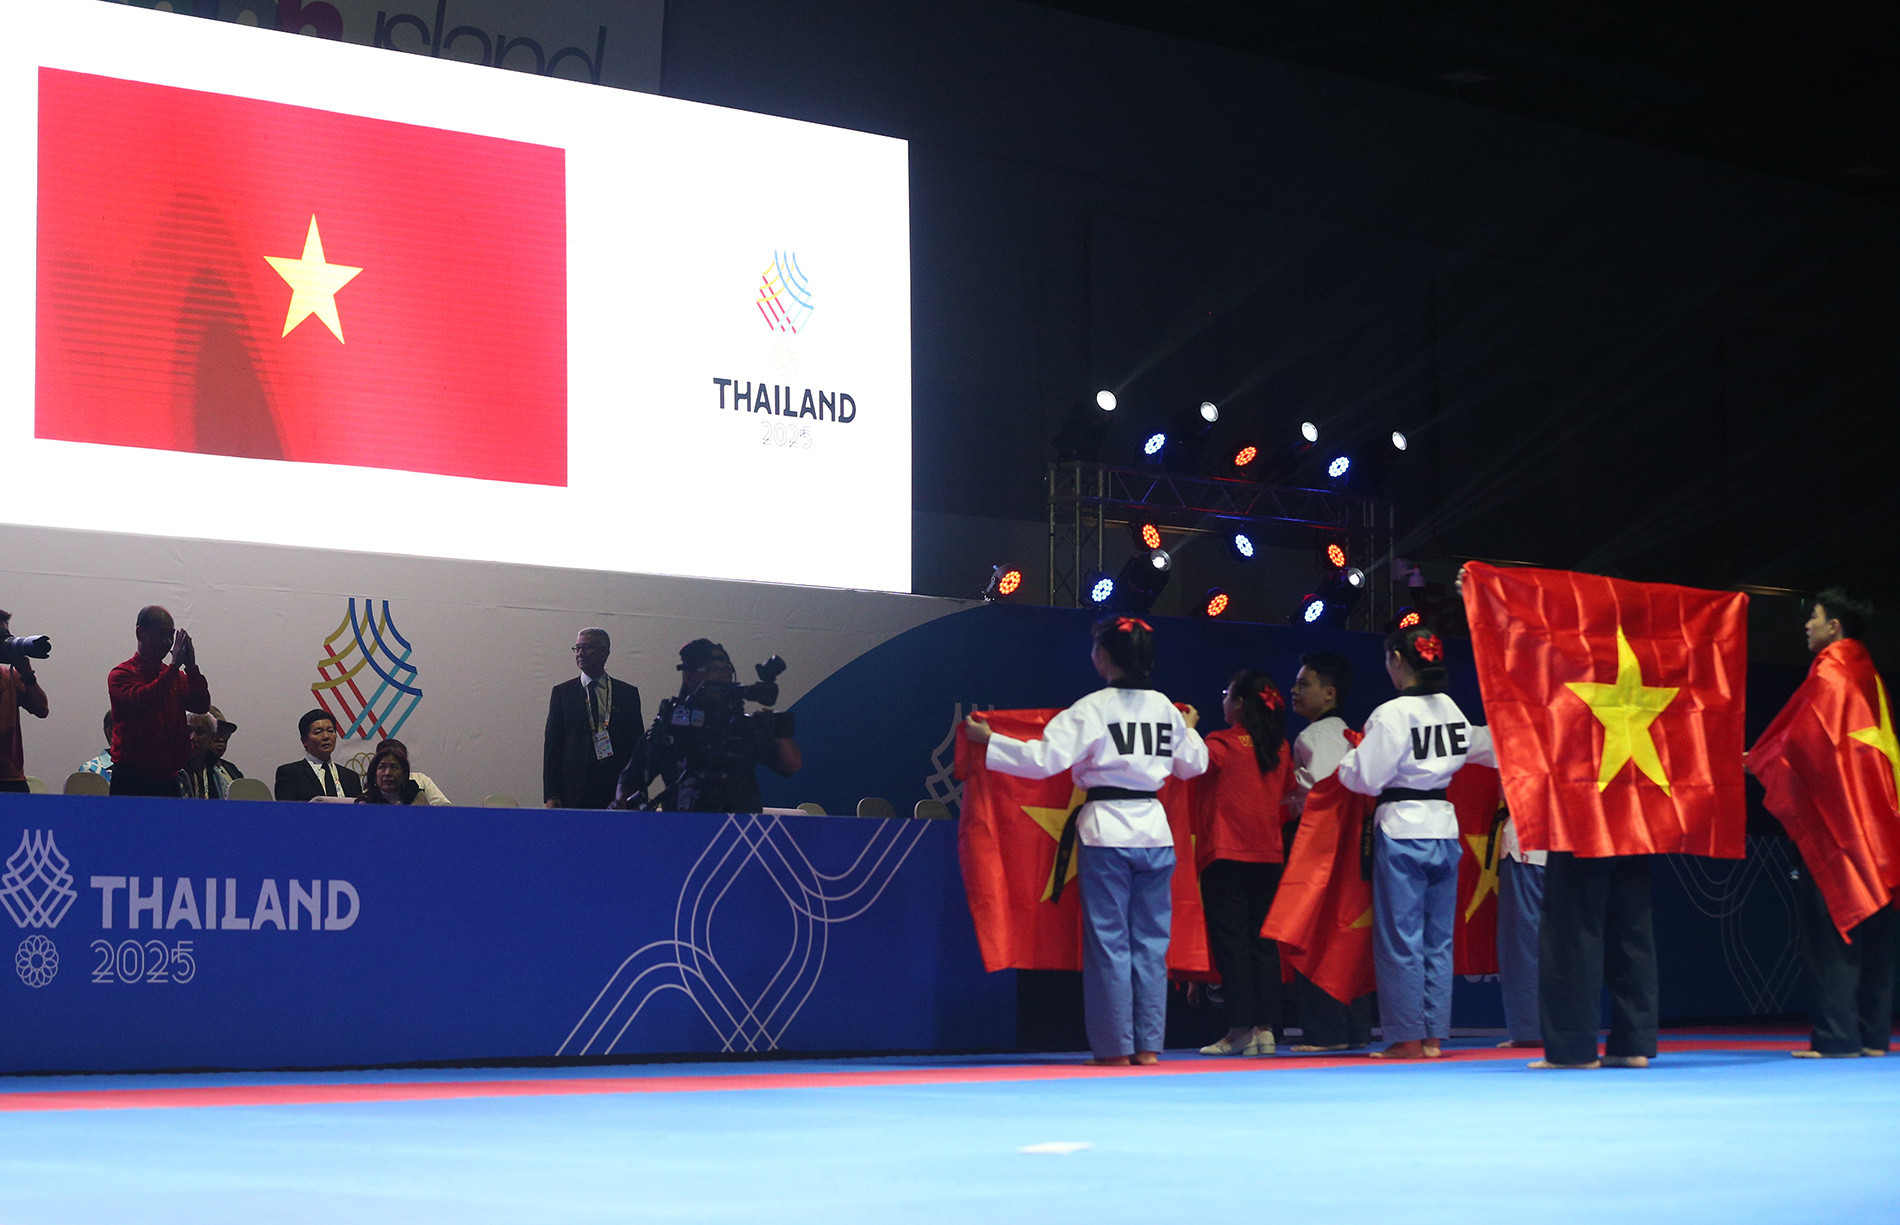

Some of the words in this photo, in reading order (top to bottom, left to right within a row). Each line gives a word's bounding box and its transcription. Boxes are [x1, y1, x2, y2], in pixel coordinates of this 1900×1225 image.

[713, 377, 856, 423] THAILAND
[761, 421, 813, 449] 2025
[1108, 722, 1173, 758] VIE
[1410, 722, 1468, 760] VIE
[90, 875, 361, 931] THAILAND
[90, 939, 196, 984] 2025
